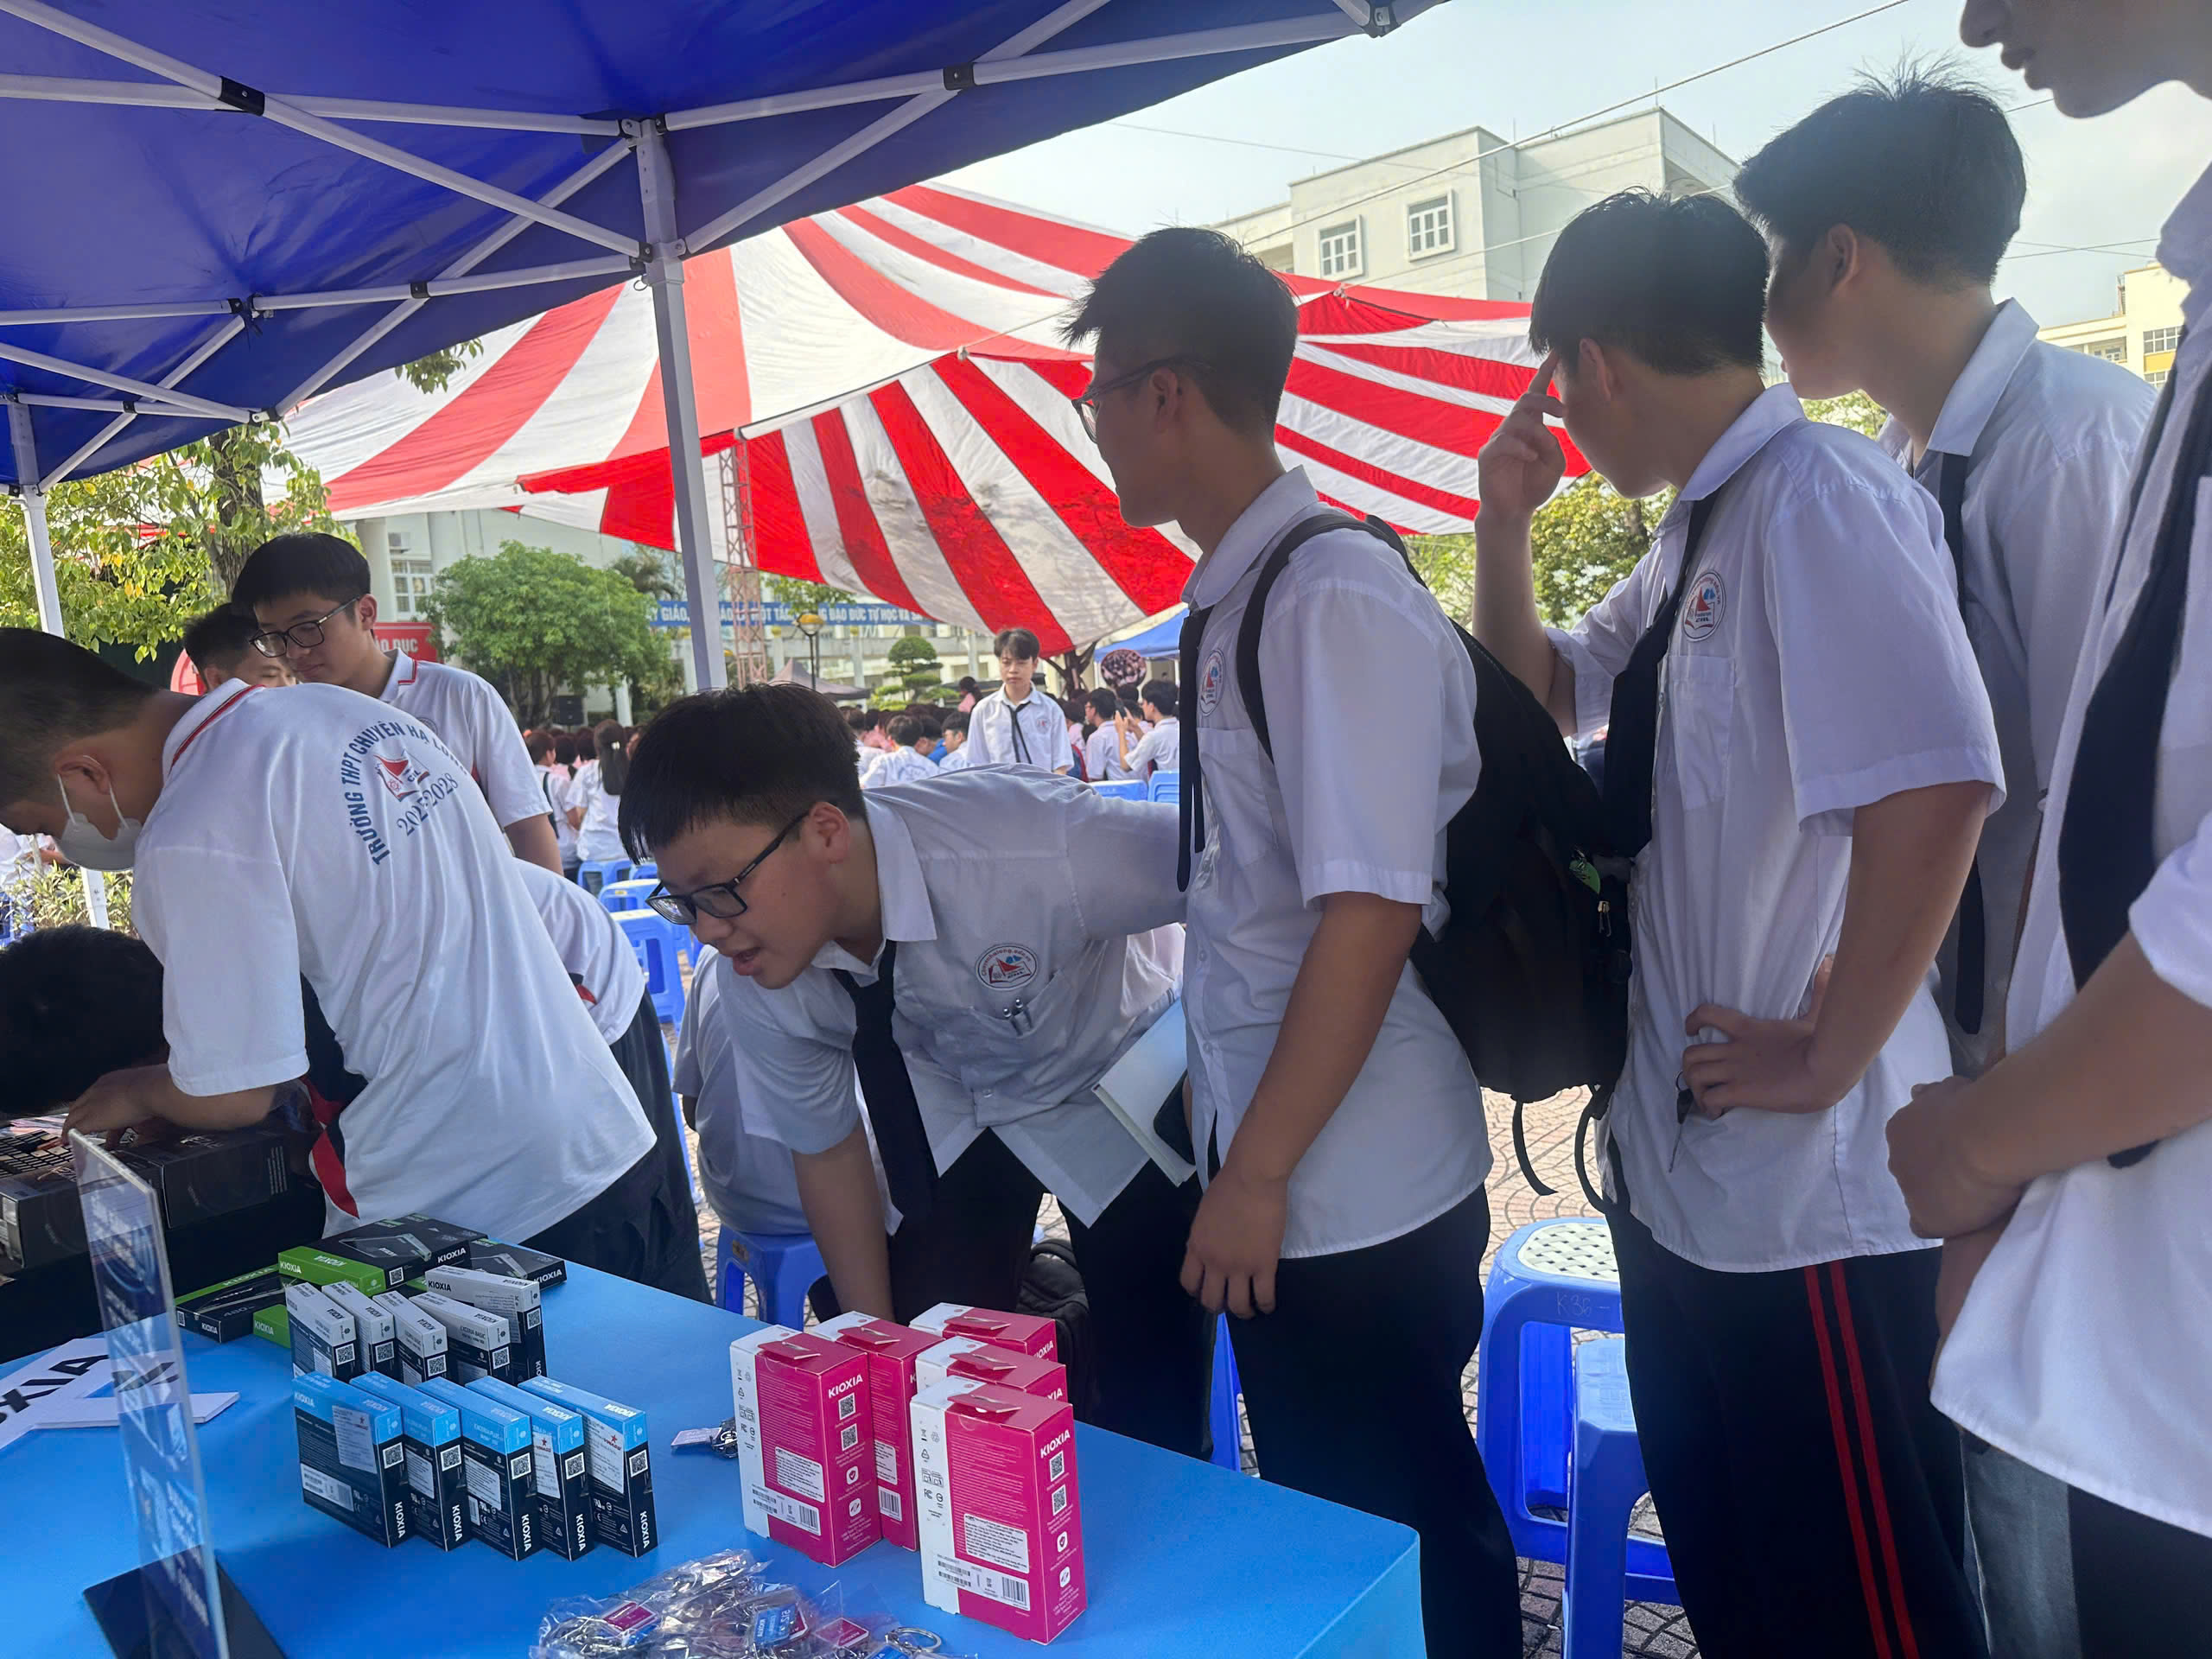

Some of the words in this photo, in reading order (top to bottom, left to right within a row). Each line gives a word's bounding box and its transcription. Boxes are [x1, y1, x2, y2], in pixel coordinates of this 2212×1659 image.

[348, 721, 406, 755] CHUYÊN
[406, 724, 430, 744] HẠ
[341, 752, 362, 785] THPT
[345, 791, 391, 865] TRƯỜNG
[437, 1247, 467, 1263] KIOXIA
[280, 1261, 302, 1274] KIOXIA
[533, 1268, 563, 1284] KIOXIA
[428, 1281, 452, 1292] KIOXIA
[201, 1322, 219, 1335] KIOXIA
[254, 1320, 274, 1335] KIOXIA
[828, 1374, 863, 1399] KIOXIA
[294, 1390, 315, 1408] KIOXIA
[543, 1407, 573, 1421] KIOXIA
[604, 1403, 637, 1418] KIOXIA
[1039, 1428, 1071, 1459] KIOXIA
[394, 1501, 406, 1538] KIOXIA
[452, 1504, 463, 1541] KIOXIA
[639, 1510, 651, 1548] KIOXIA
[521, 1513, 532, 1552] KIOXIA
[575, 1513, 587, 1552] KIOXIA
